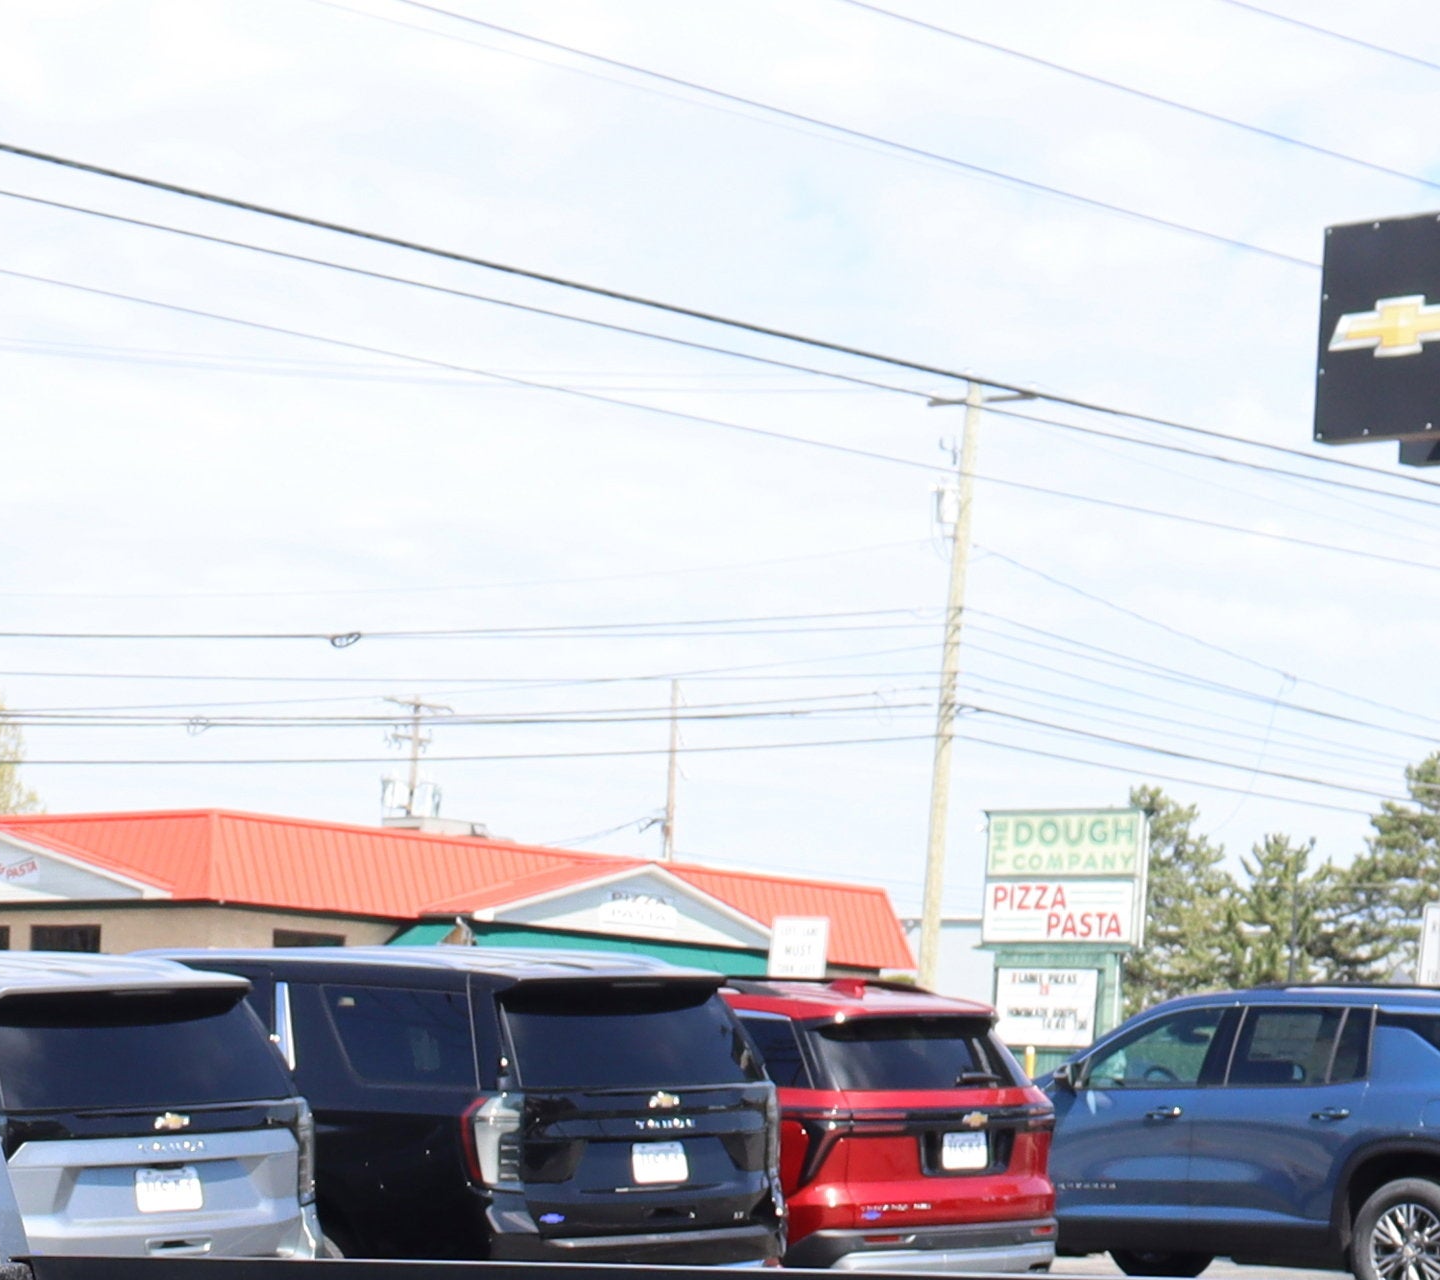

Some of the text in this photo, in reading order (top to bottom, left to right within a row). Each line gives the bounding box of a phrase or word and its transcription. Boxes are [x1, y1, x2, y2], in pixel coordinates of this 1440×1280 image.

[1013, 819, 1133, 846] DOUGH
[1013, 854, 1133, 870] COMPANY
[993, 885, 1066, 910] PIZZA
[1046, 912, 1122, 938] PASTA
